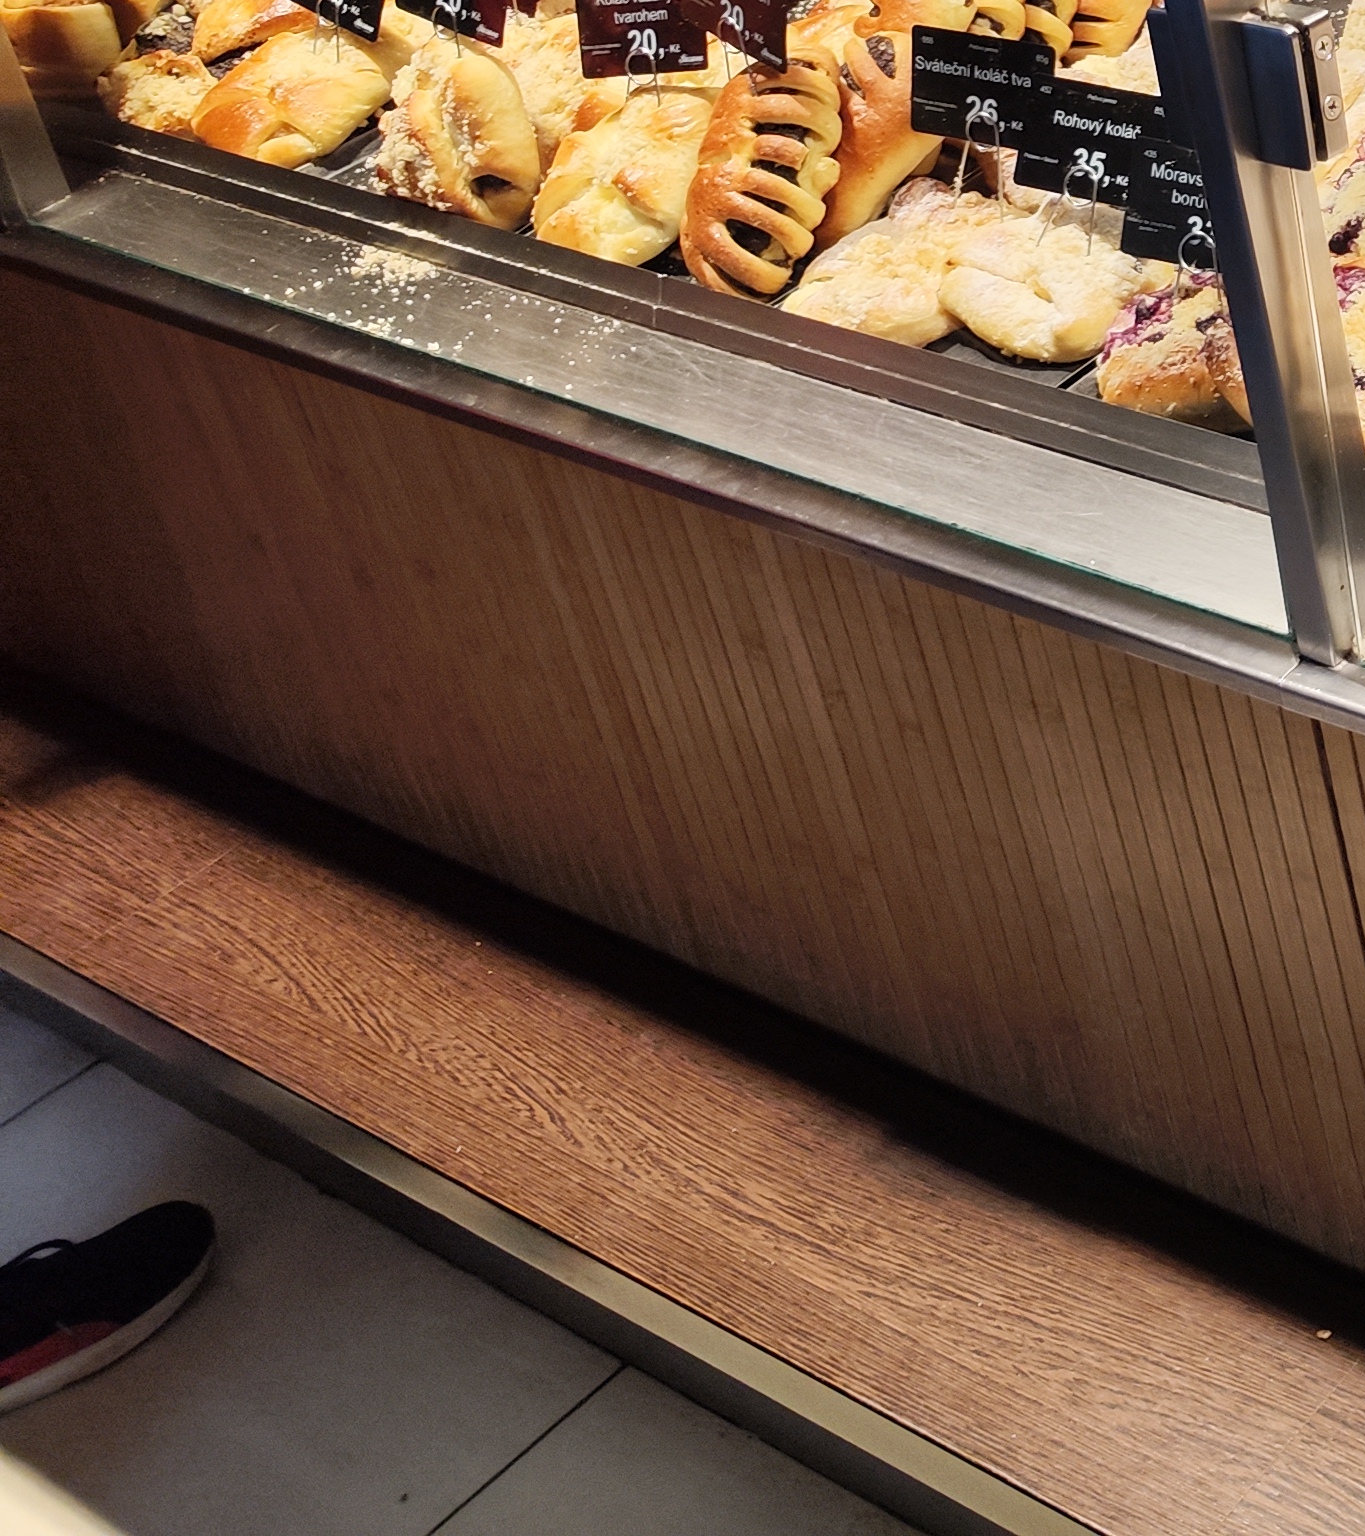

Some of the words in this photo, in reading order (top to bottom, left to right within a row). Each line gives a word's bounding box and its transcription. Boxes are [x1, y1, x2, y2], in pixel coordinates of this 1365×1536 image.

[613, 8, 668, 25] tvarohem
[915, 56, 971, 78] Sváteční
[973, 64, 1010, 88] koláč
[1053, 110, 1105, 136] Rohový
[1105, 120, 1142, 141] koláč
